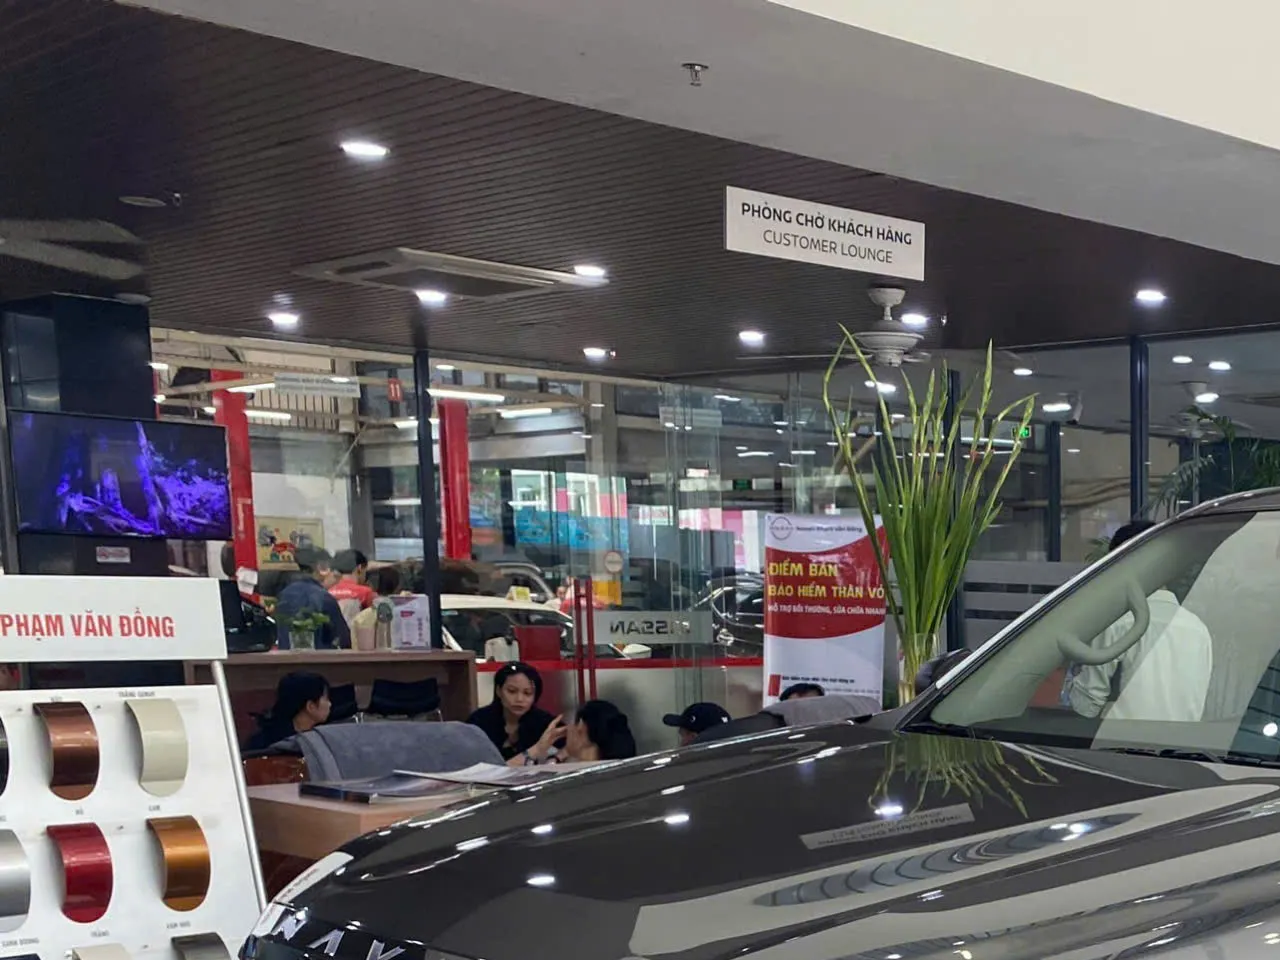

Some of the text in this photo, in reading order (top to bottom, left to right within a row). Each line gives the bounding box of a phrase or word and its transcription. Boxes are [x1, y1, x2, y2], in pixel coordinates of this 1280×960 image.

[741, 201, 912, 245] PHÒNG CHỜ KHÁCH HÀNG
[763, 229, 893, 263] CUSTOMER LOUNGE
[767, 581, 794, 597] BẢO
[798, 580, 827, 597] HIỂM
[831, 583, 863, 598] THÂN
[0, 606, 175, 642] PHẠM VĂN ĐỒNG
